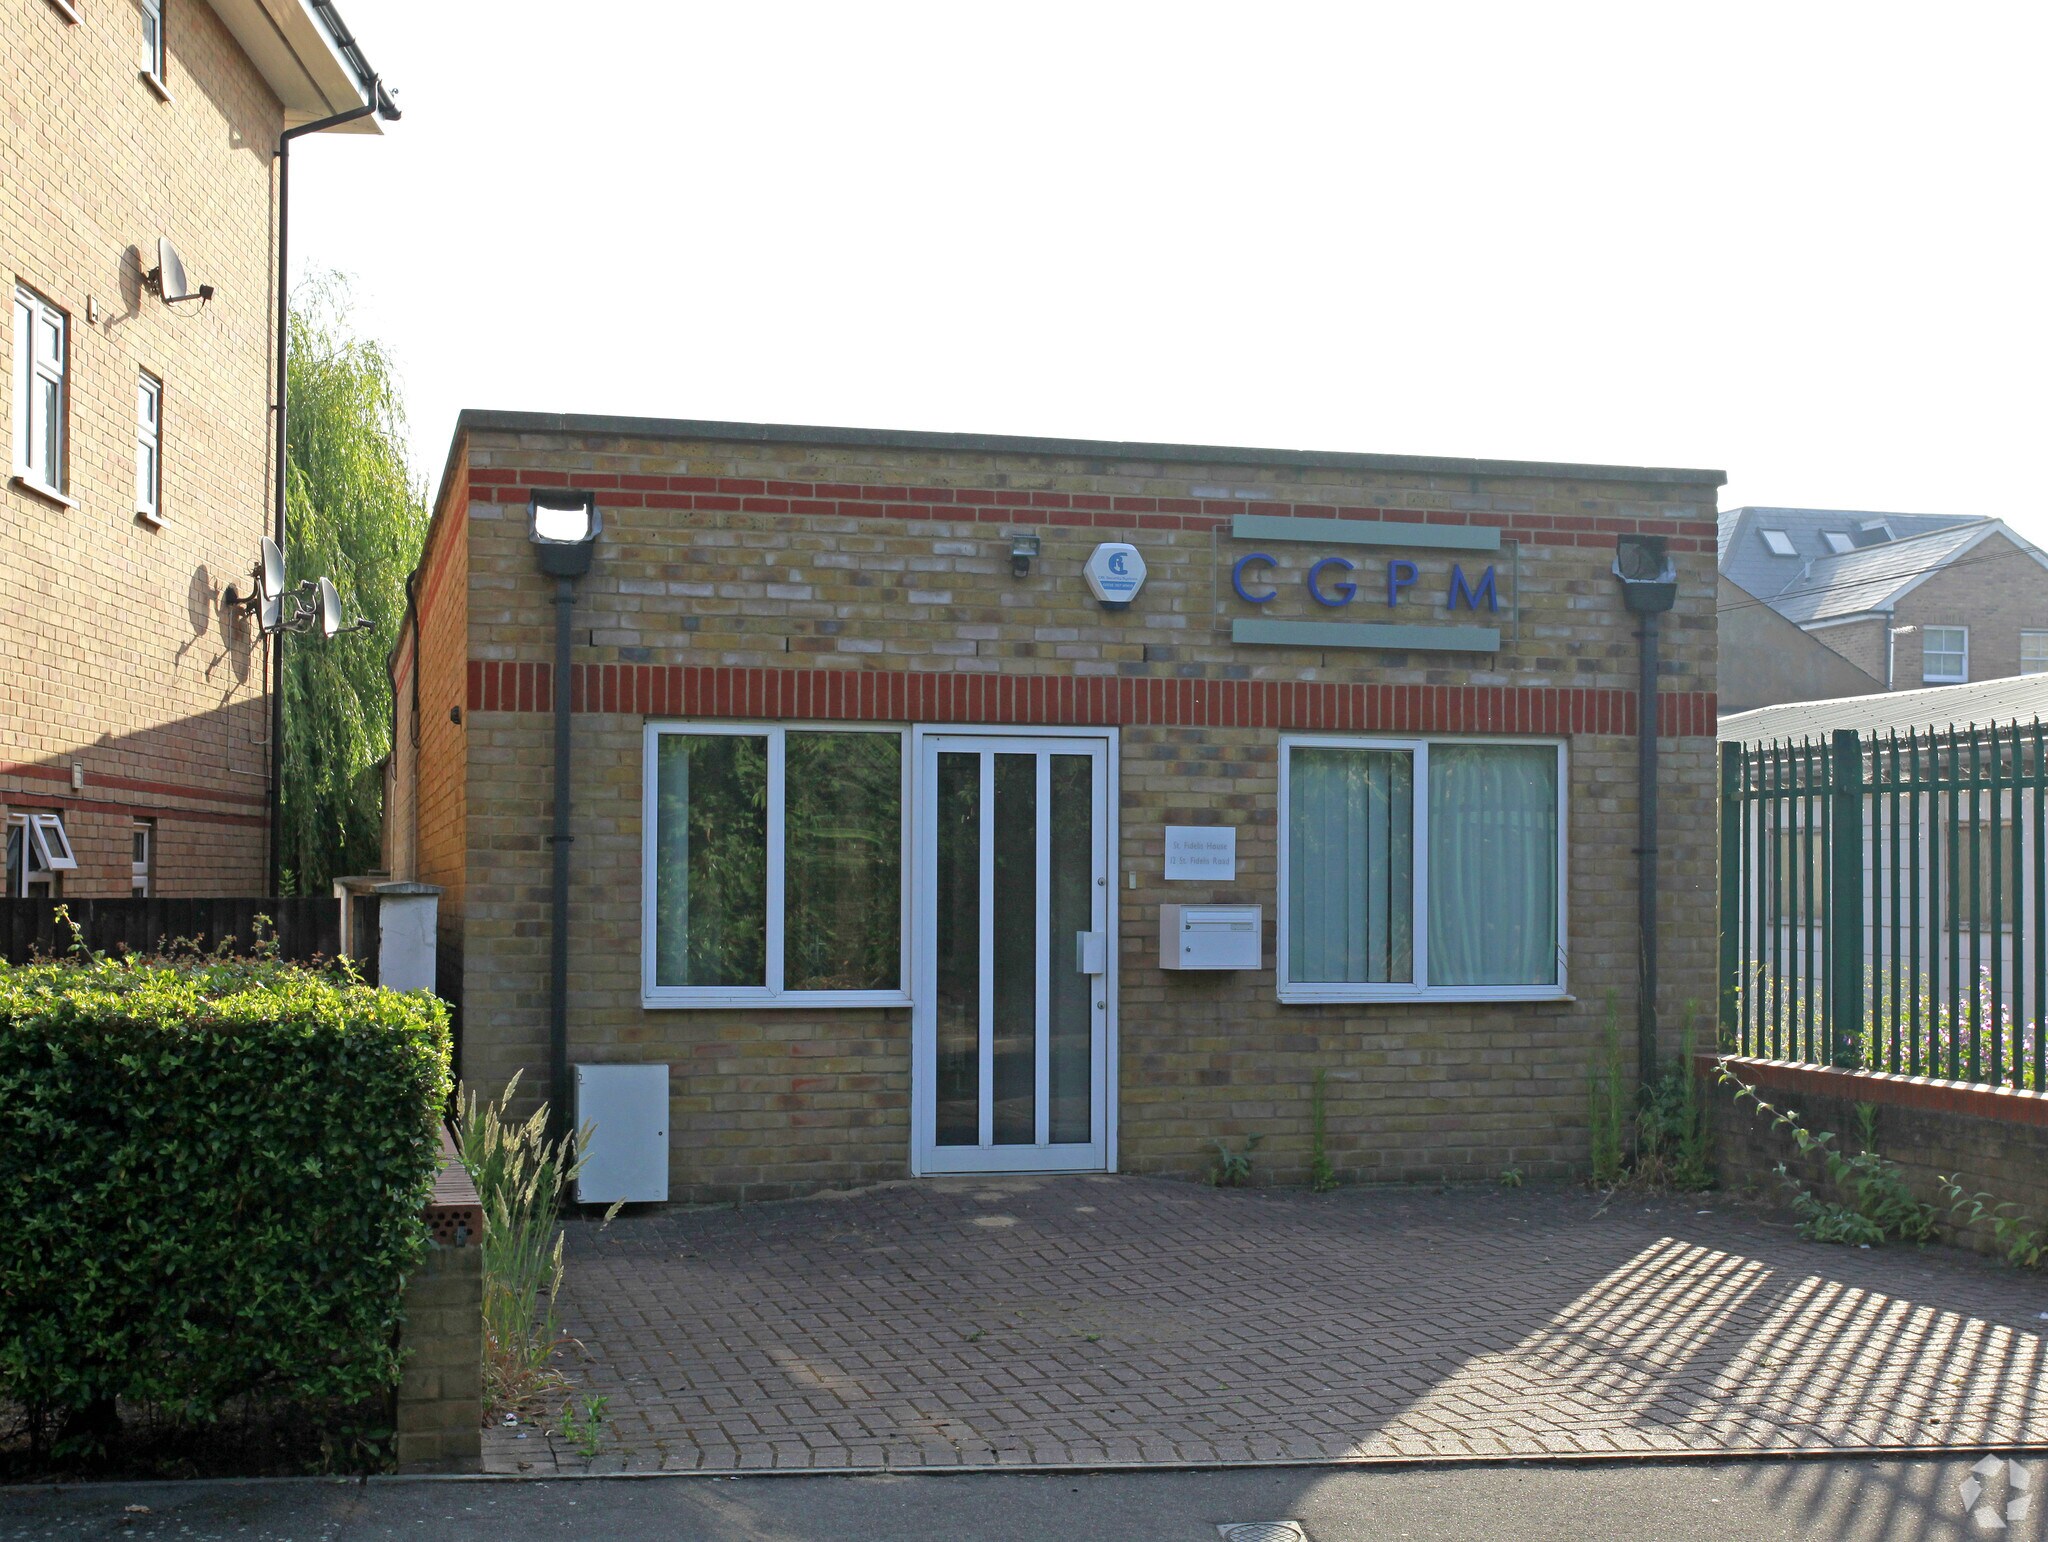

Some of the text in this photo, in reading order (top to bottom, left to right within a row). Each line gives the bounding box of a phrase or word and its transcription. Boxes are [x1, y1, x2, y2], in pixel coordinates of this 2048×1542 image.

[1184, 841, 1204, 850] Fidelis
[1206, 842, 1228, 850] House
[1190, 856, 1210, 865] Fidelis
[1212, 856, 1230, 866] Road
